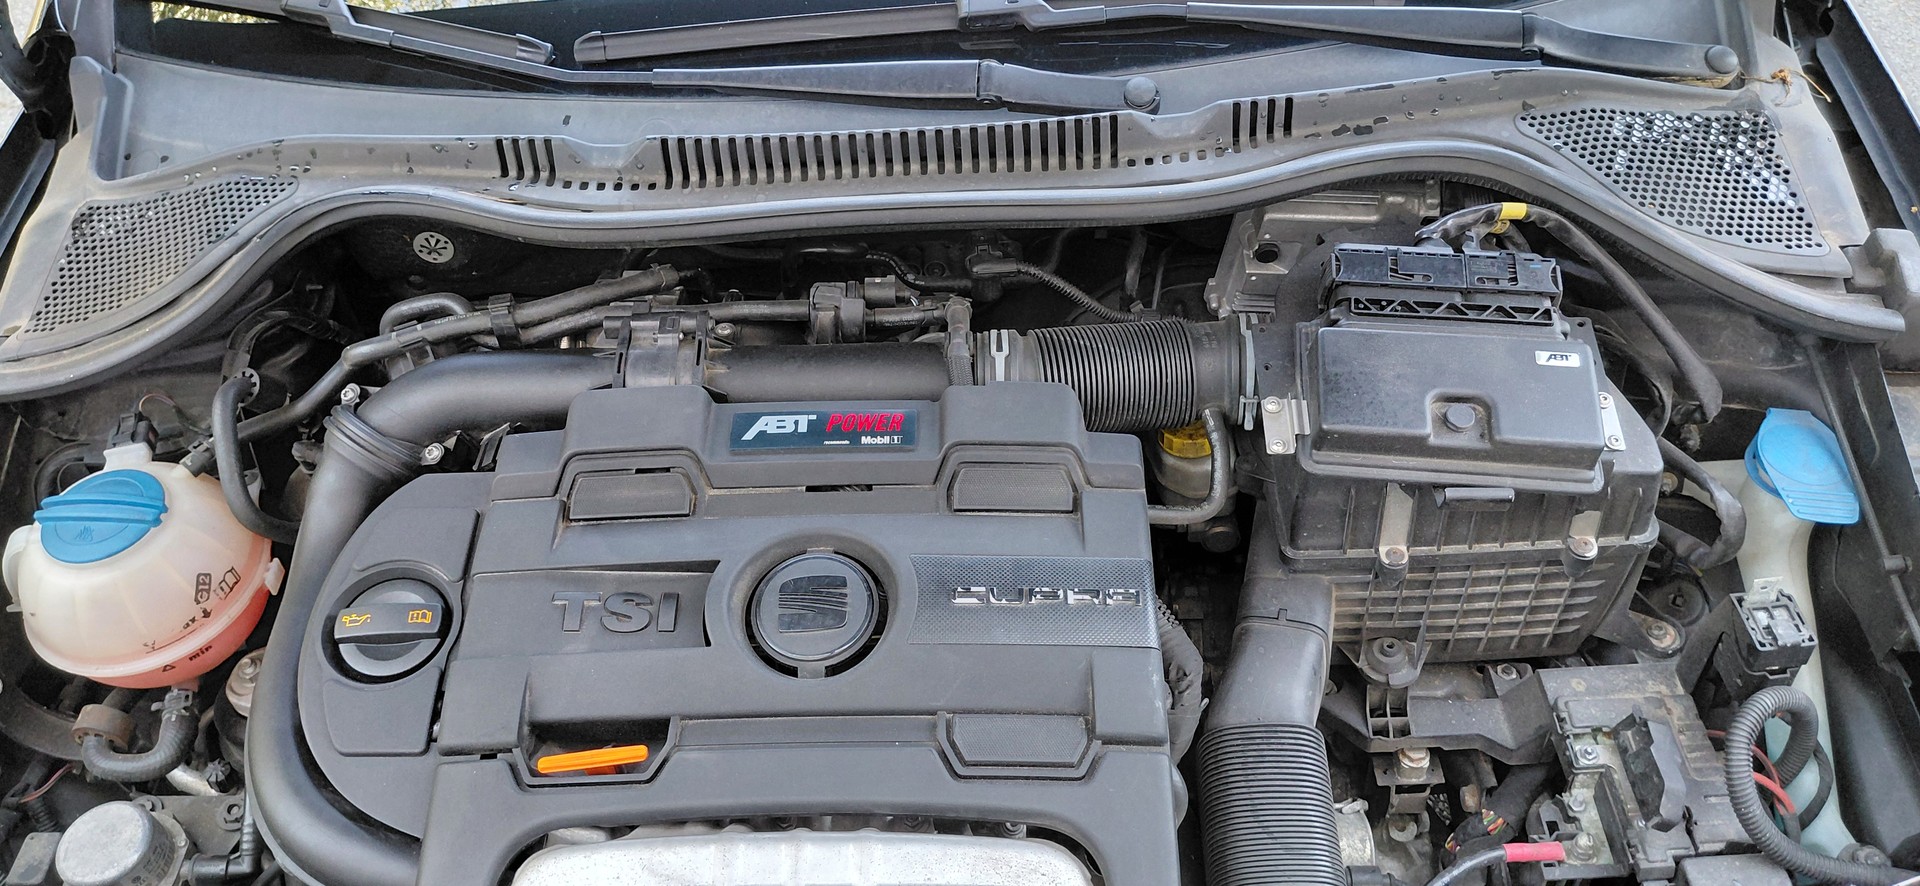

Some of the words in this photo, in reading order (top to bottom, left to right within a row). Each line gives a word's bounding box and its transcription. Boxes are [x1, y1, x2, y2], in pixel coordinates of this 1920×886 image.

[1545, 353, 1572, 362] ABT
[741, 414, 817, 441] ABT
[826, 413, 905, 432] POWER
[861, 435, 890, 445] Mobil
[951, 587, 1142, 606] CUPRA
[551, 591, 680, 633] TSI
[188, 645, 213, 661] min
